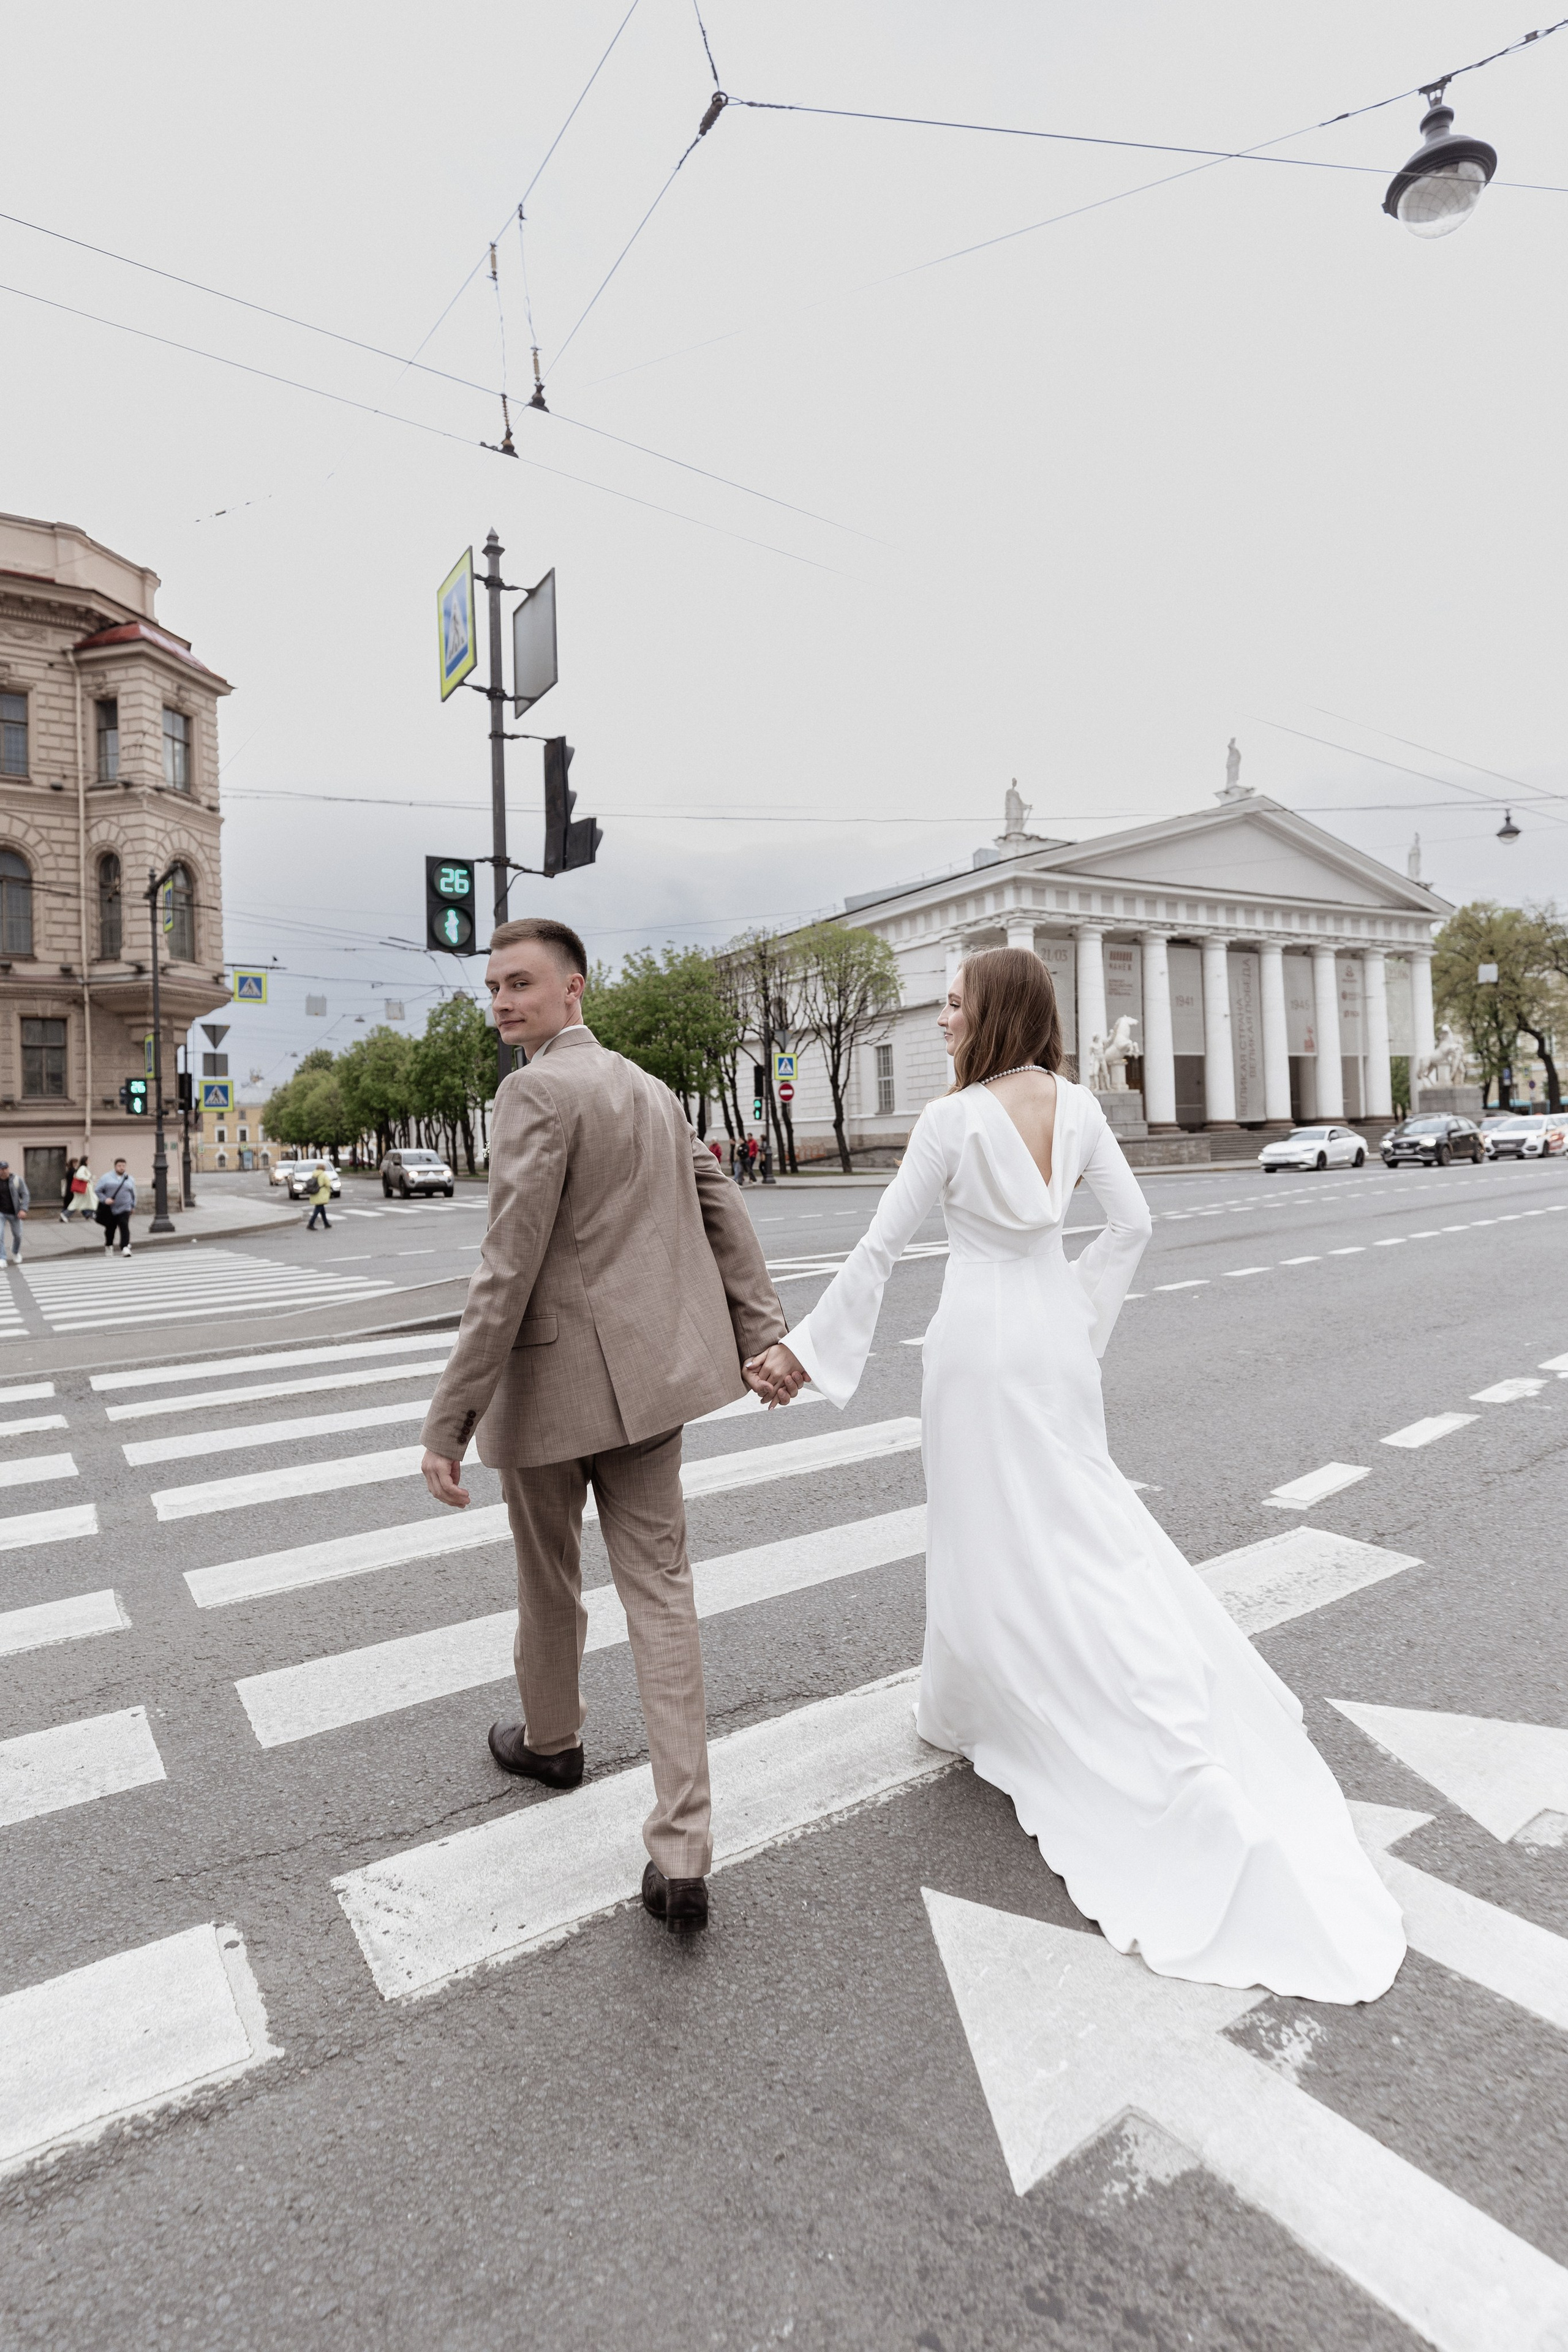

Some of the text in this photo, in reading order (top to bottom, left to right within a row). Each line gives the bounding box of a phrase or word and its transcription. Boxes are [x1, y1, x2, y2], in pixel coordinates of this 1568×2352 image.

[439, 867, 469, 894] 26
[1175, 995, 1194, 1007] 1941
[1290, 999, 1310, 1010] 1945
[1236, 998, 1246, 1050] СТРАНА
[1242, 958, 1257, 1079] ВЕЛИКАЯ ПОБЕДА
[130, 1080, 146, 1093] 26
[1238, 1054, 1248, 1116] ВЕЛИКАЯ
